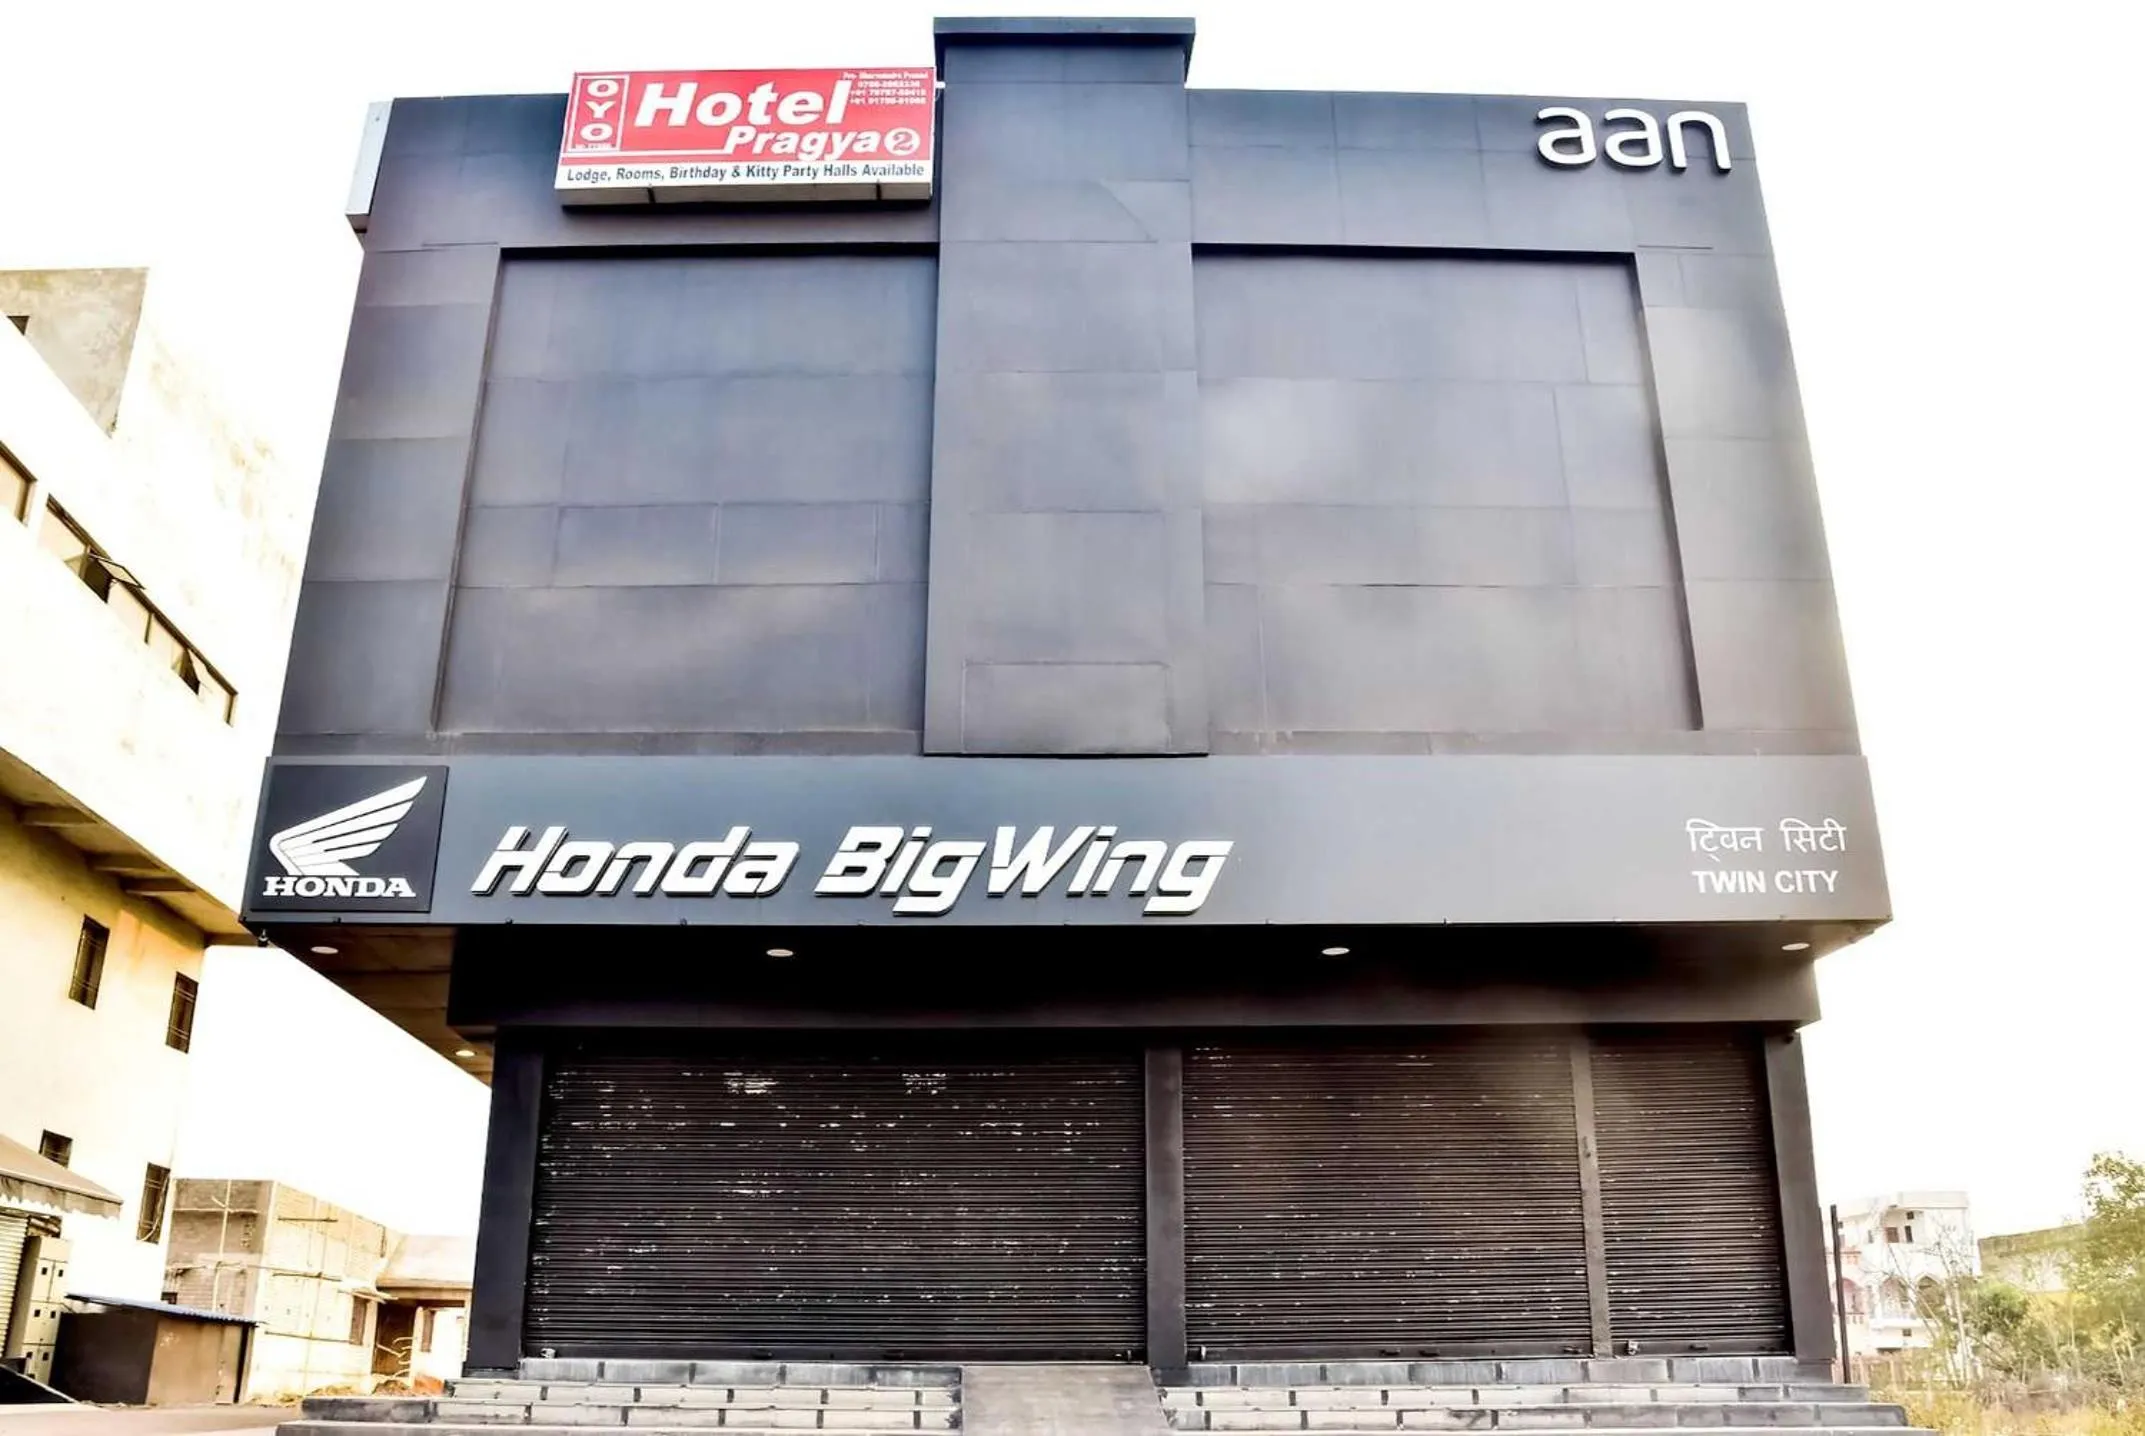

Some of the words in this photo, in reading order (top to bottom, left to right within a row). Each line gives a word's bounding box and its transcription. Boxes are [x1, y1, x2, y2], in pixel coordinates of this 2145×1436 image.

[580, 79, 619, 142] OYO
[634, 80, 852, 127] Hotel
[723, 125, 881, 161] Pragya
[889, 129, 916, 153] 2
[1537, 106, 1732, 172] aan
[567, 168, 611, 184] Lodge,
[616, 167, 665, 182] Rooms,
[669, 165, 727, 183] Birthday
[731, 165, 741, 178] &
[746, 164, 780, 181] Kitty
[783, 164, 820, 180] Party
[823, 163, 858, 177] Halls
[862, 163, 925, 177] Available
[1780, 817, 1847, 853] सिटी
[470, 825, 799, 899] Honda
[263, 875, 416, 898] HONDA
[1692, 870, 1767, 894] TWIN
[1774, 870, 1839, 894] CITY
